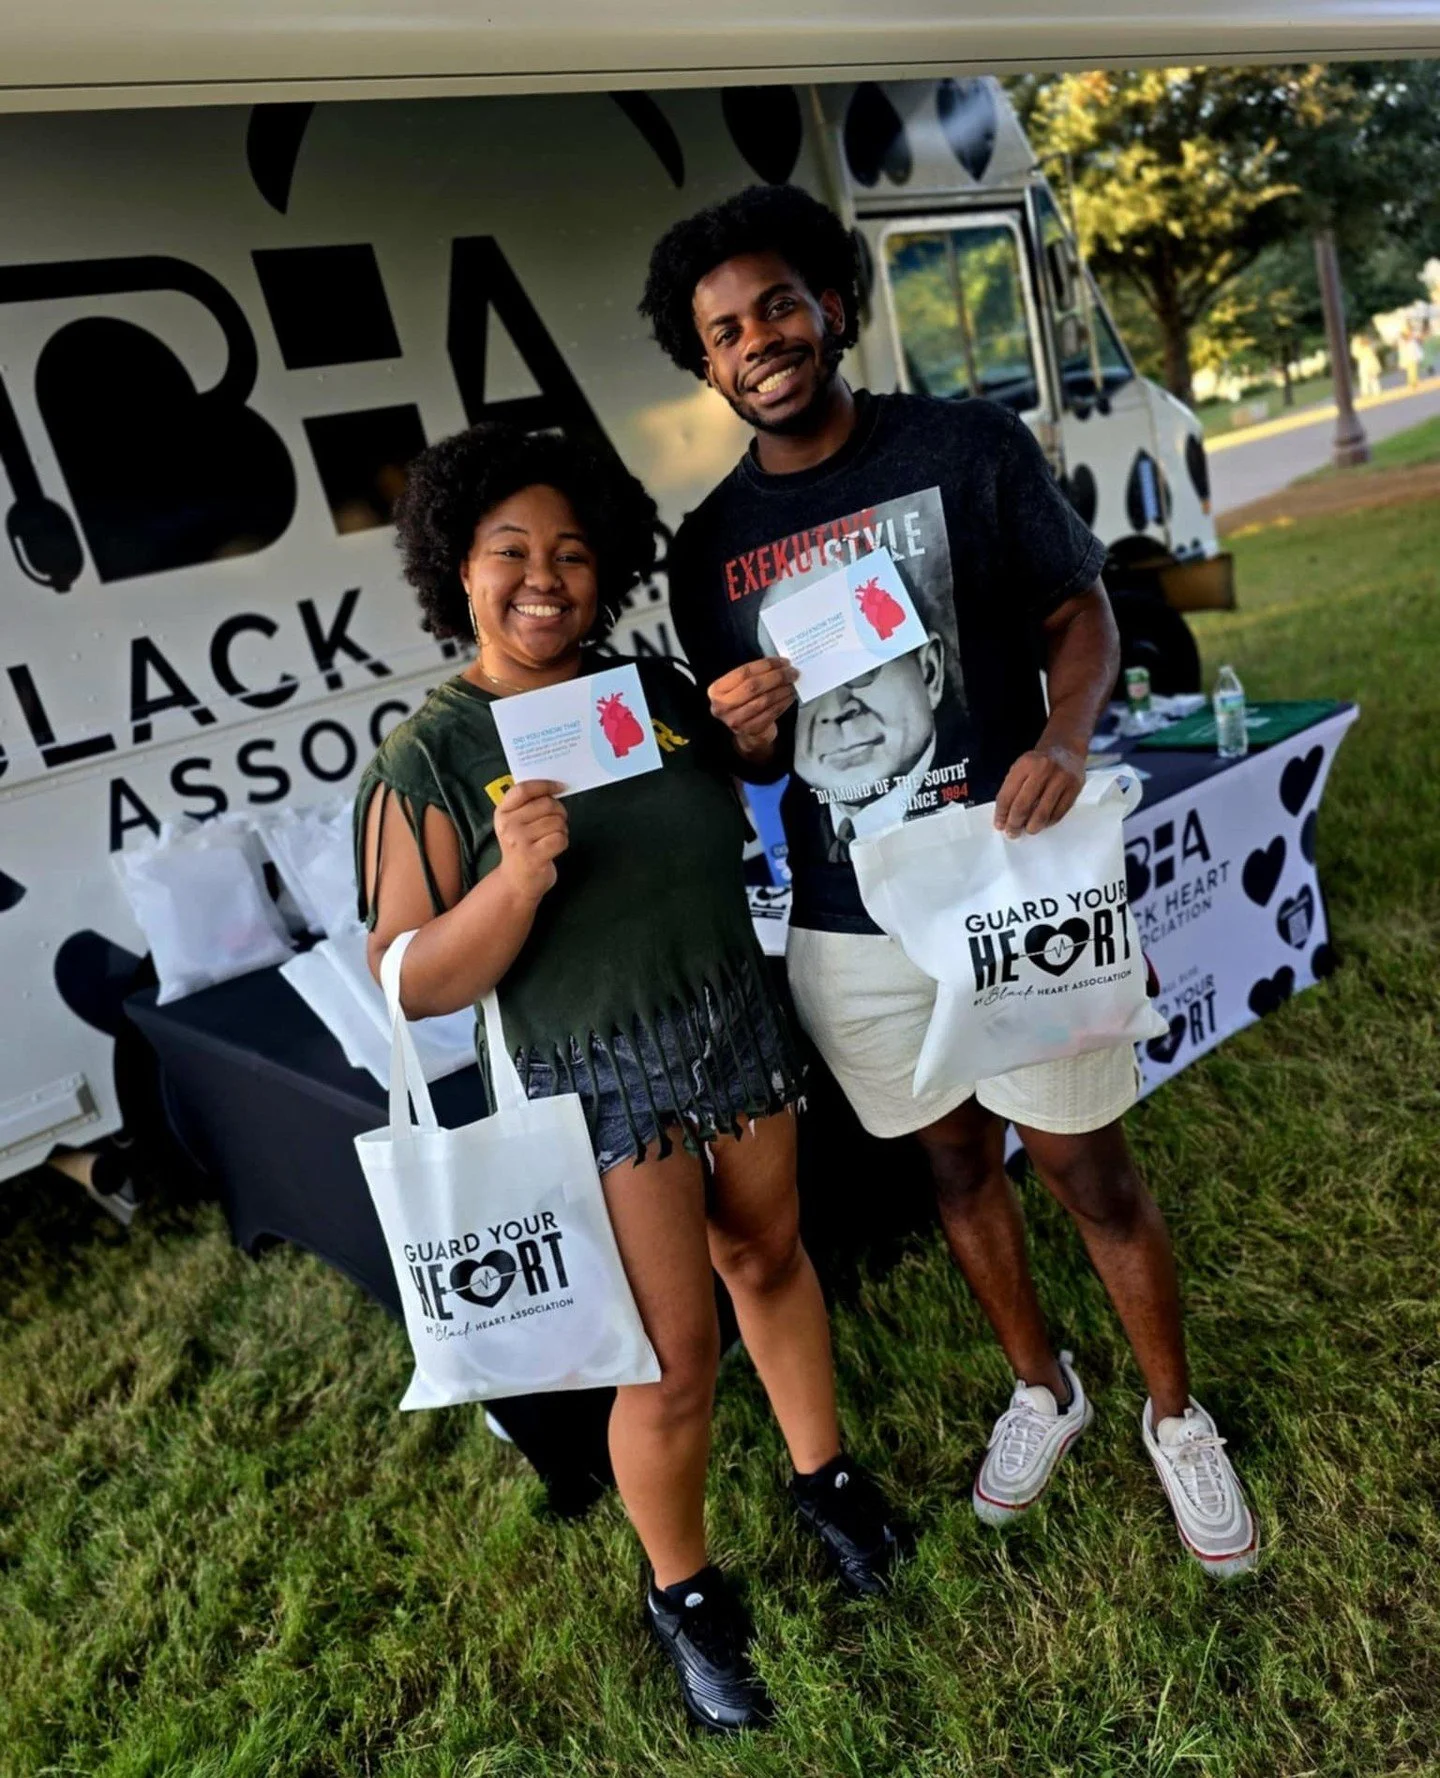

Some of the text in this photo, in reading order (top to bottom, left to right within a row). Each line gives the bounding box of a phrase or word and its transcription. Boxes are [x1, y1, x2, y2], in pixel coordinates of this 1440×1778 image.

[0, 587, 393, 778] LACK
[110, 690, 434, 852] ASSOC
[875, 778, 891, 795] OF
[894, 773, 921, 791] THE
[900, 782, 969, 811] SINCE 1994
[965, 879, 1128, 933] GUARD YOUR
[1164, 860, 1230, 916] HEART
[1139, 896, 1213, 949] OCIATION
[1037, 984, 1069, 996] HEART
[1072, 969, 1132, 991] ASSOCIATION
[1174, 973, 1214, 1009] YOUR
[404, 1211, 558, 1263] GUARD YOUR
[475, 1316, 506, 1331] HEART
[510, 1298, 574, 1321] ASSOCIATION
